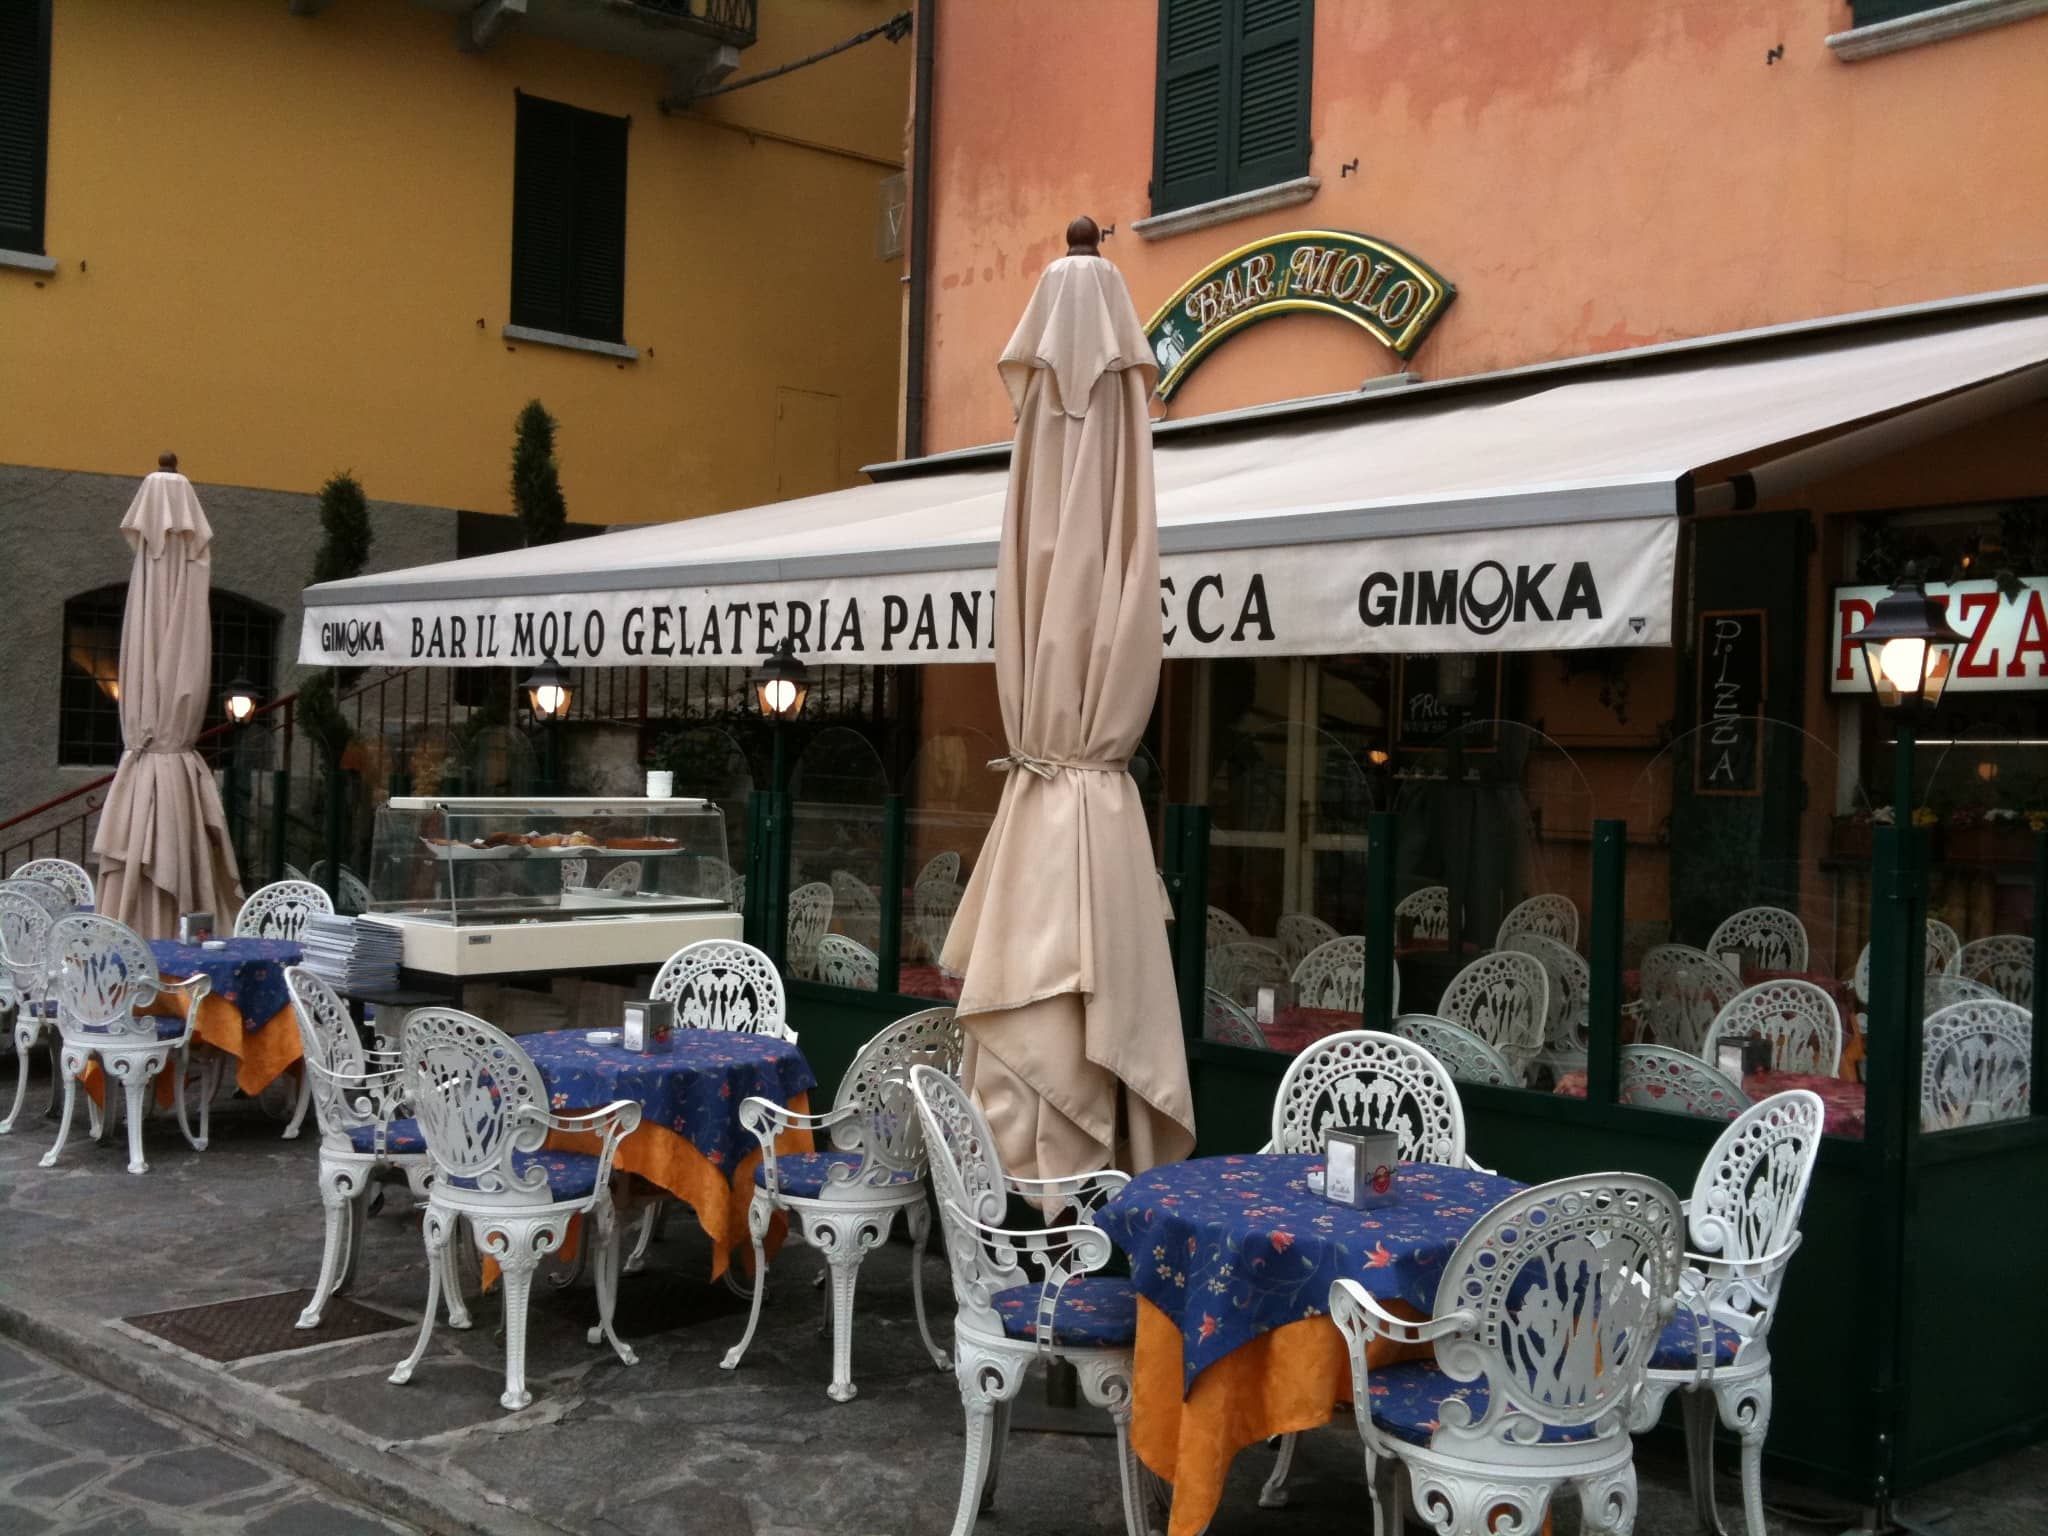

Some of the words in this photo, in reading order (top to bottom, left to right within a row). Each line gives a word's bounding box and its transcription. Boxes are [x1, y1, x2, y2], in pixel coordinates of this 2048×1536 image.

[1186, 254, 1275, 334] BAR
[1290, 246, 1421, 328] MOLO
[411, 615, 467, 658] BAR
[476, 614, 499, 658] IL
[511, 609, 605, 659] MOLO
[622, 597, 865, 658] GELATERIA
[1358, 560, 1603, 636] GIMOKA
[1836, 589, 2048, 681] PZA
[321, 618, 384, 657] GIMOKA
